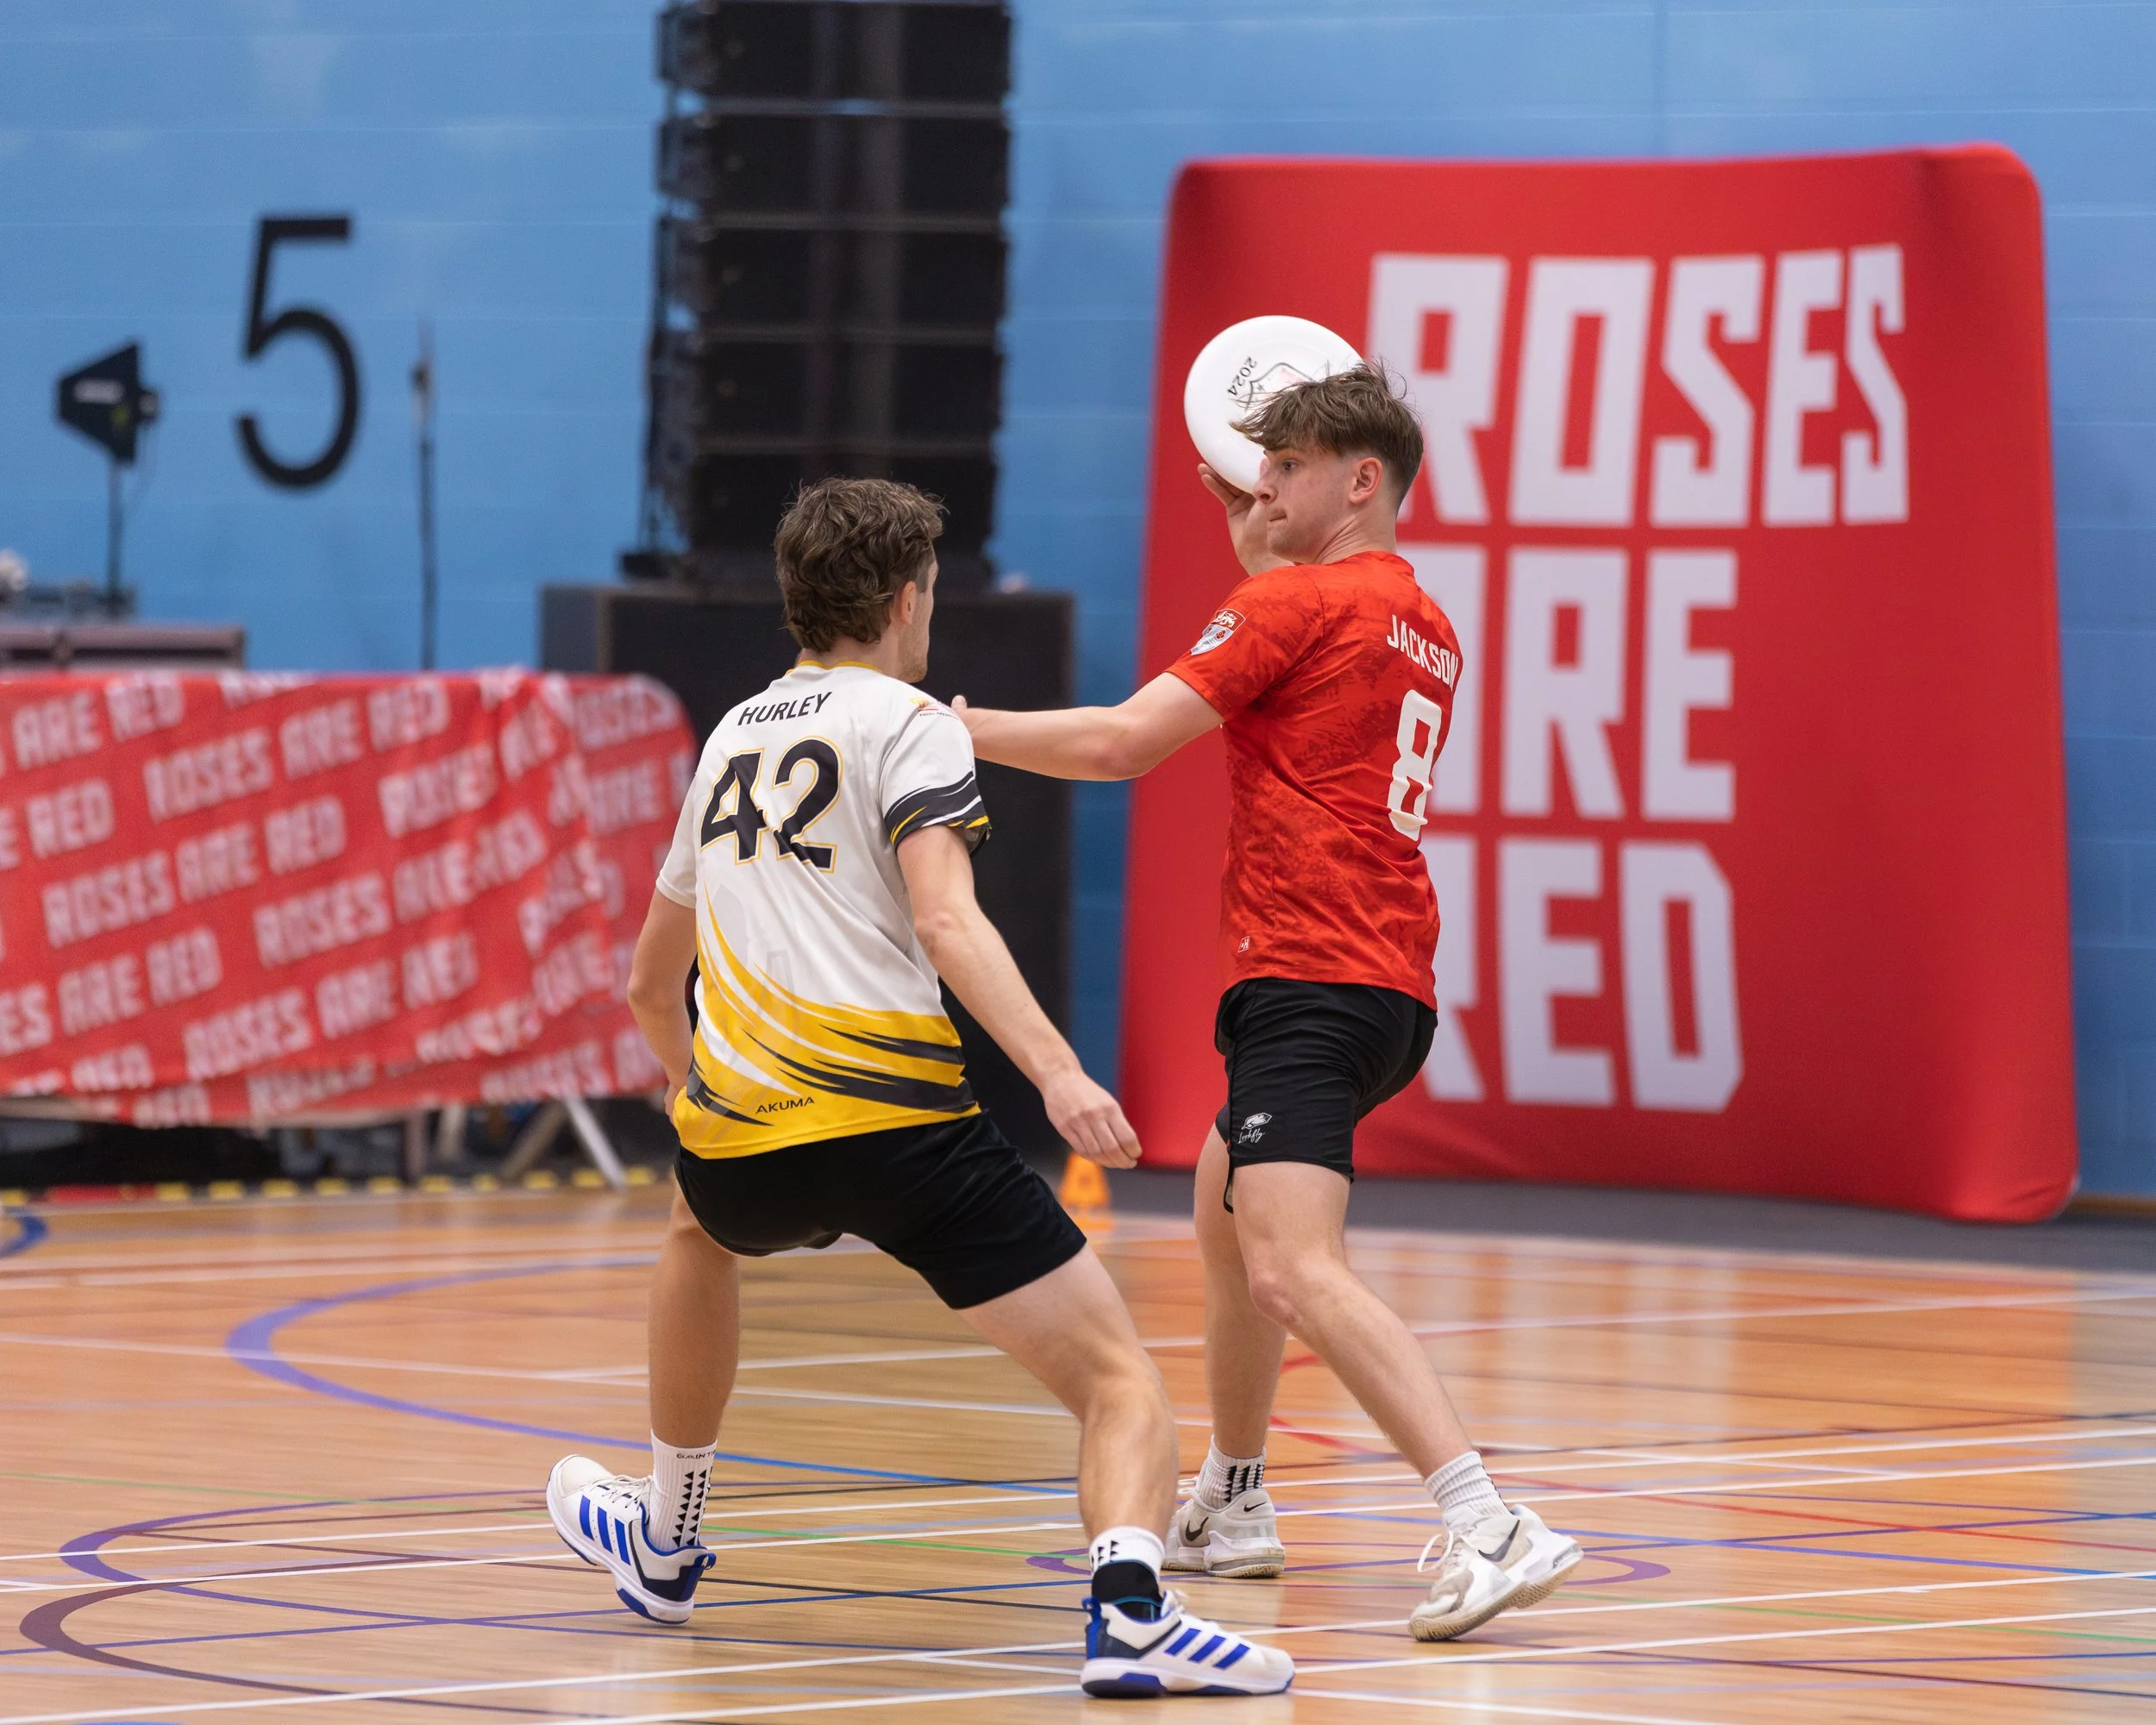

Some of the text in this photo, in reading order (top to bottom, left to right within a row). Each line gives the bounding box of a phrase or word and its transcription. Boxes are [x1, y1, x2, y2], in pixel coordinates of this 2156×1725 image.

[239, 216, 359, 488] 5
[1227, 356, 1258, 396] 2024
[1367, 240, 1908, 528] ROSES
[1387, 614, 1458, 692] JACKSON
[737, 692, 832, 725] HURLEY
[699, 735, 843, 874] 42
[1387, 689, 1442, 842] 8
[755, 1096, 815, 1114] AKUMA
